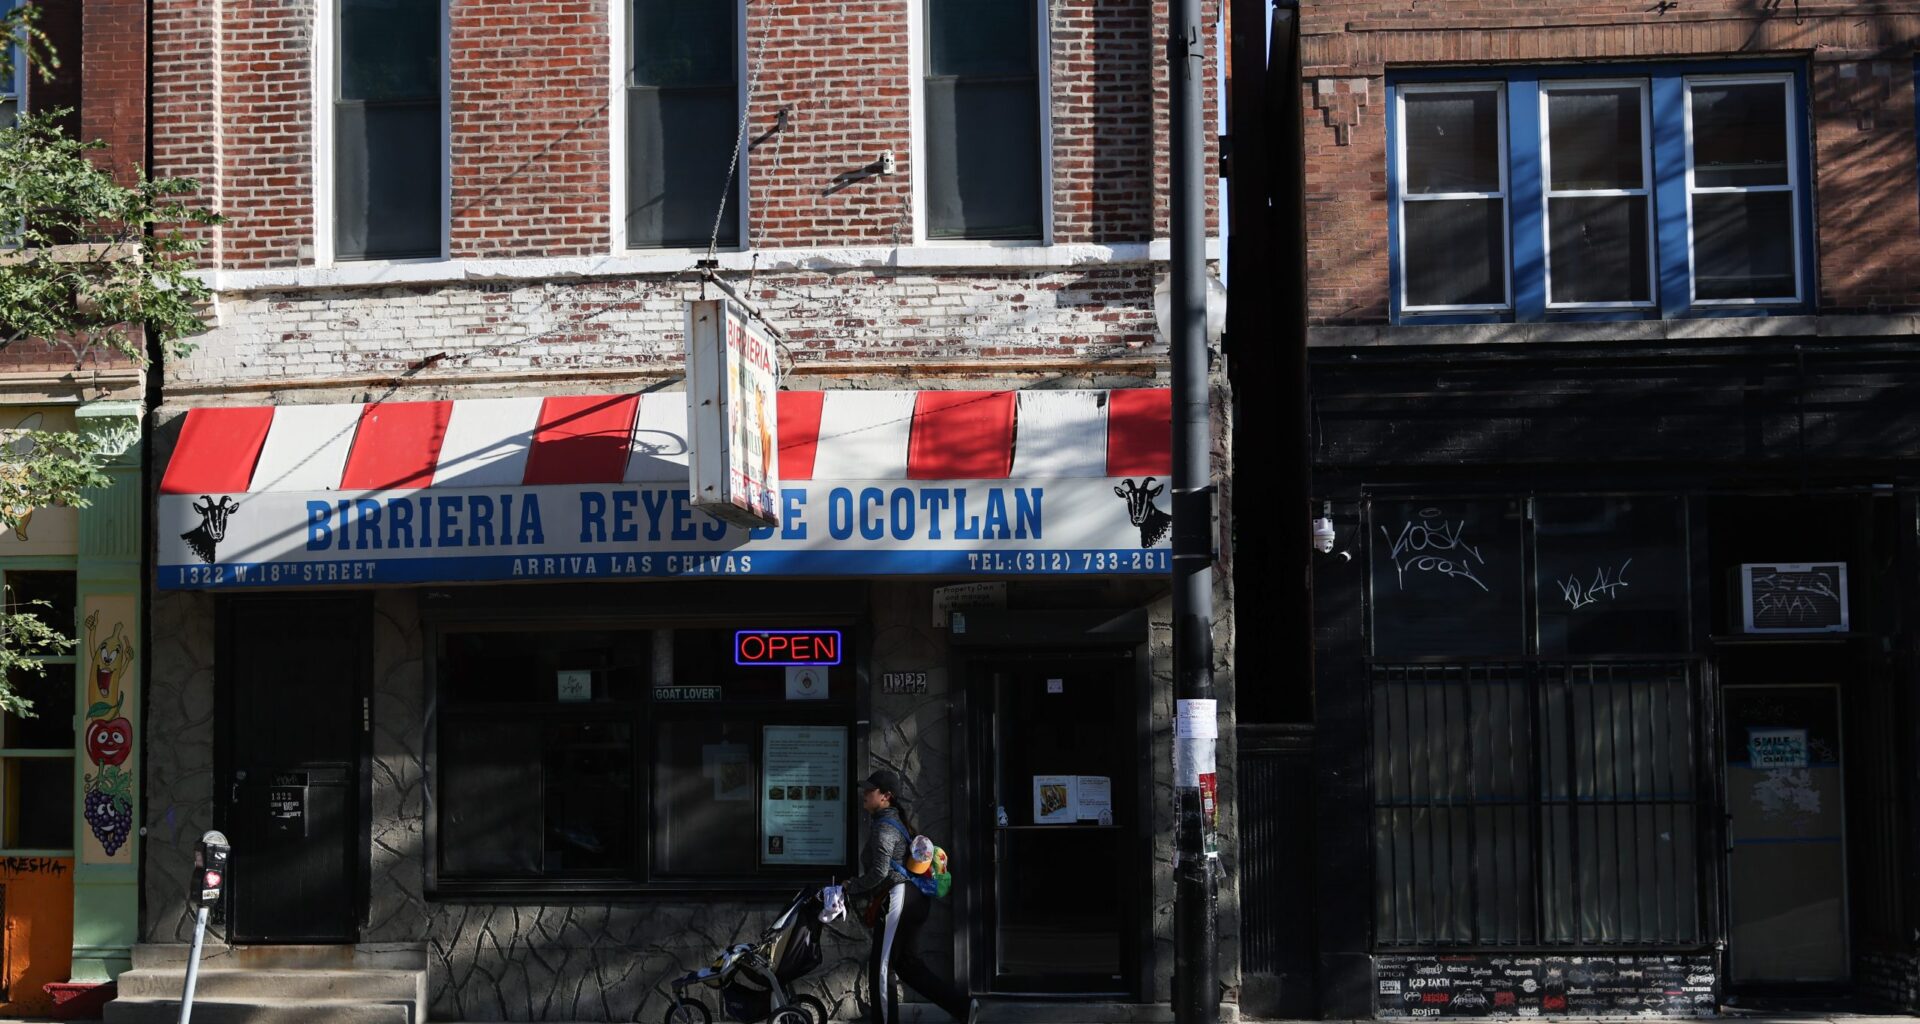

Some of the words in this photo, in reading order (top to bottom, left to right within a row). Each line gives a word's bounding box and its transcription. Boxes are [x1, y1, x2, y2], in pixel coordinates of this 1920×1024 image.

[728, 318, 771, 374] BIRRIERIA
[306, 493, 545, 551] BIRRIERIA
[580, 491, 729, 543] REYES
[748, 489, 807, 541] E
[828, 487, 1043, 541] OCOTLAN
[512, 556, 597, 576] ARRIVA
[611, 556, 652, 573] LAS
[667, 555, 752, 574] CHIVAS
[1082, 552, 1167, 570] 733-261
[179, 566, 224, 584] 1322
[303, 562, 376, 581] STREET
[944, 586, 975, 594] Property
[741, 636, 834, 660] OPEN
[885, 673, 925, 689] 1322
[656, 688, 681, 700] GOAT
[684, 688, 714, 700] LOVER
[1754, 736, 1790, 747] SMILE
[1409, 978, 1426, 989] ICED
[1427, 978, 1450, 989] EARTH
[1412, 1007, 1441, 1016] gojira
